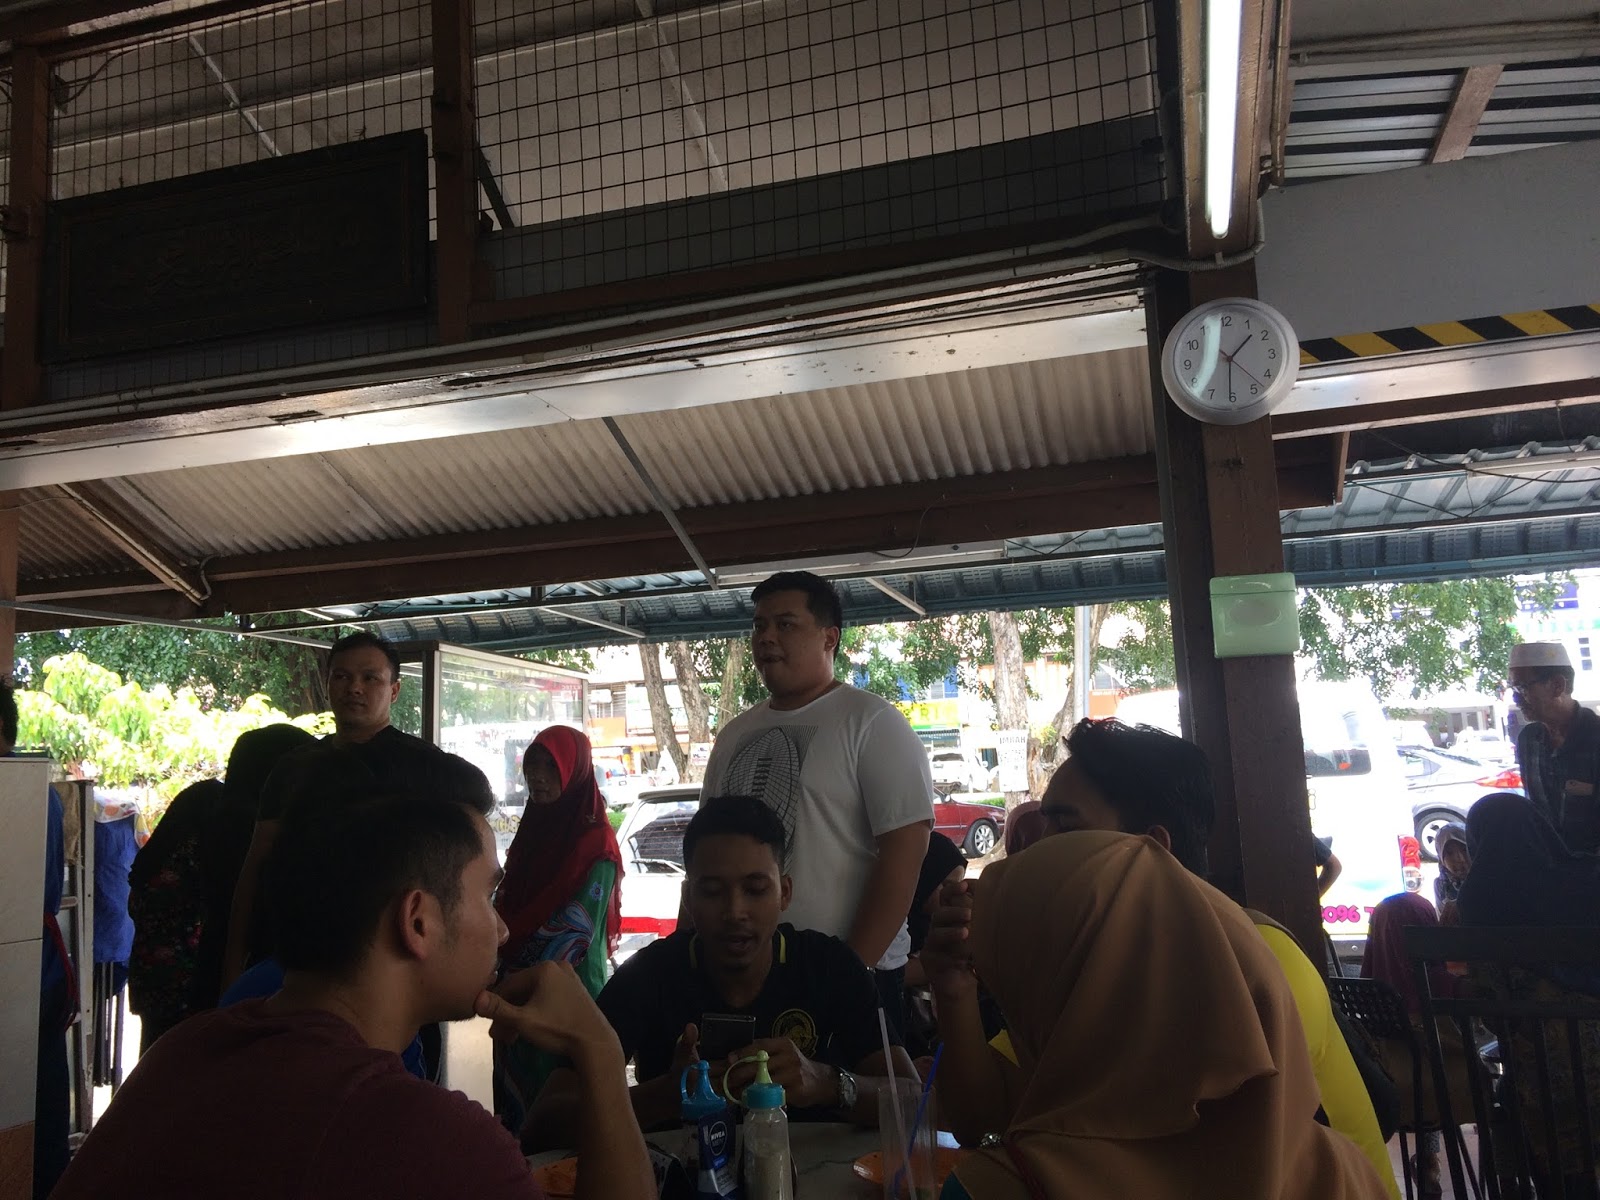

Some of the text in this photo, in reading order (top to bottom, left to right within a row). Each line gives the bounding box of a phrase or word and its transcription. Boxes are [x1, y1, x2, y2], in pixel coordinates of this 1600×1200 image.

[1220, 316, 1232, 327] 12
[1245, 320, 1251, 330] 1
[1261, 330, 1269, 341] 2
[1186, 340, 1199, 351] 10
[1268, 348, 1276, 359] 3
[1184, 360, 1192, 370] 9
[1264, 369, 1272, 378] 4
[1208, 389, 1216, 399] 7
[1250, 384, 1258, 394] 5
[1229, 392, 1237, 402] 6
[1321, 904, 1361, 923] 096
[710, 1131, 725, 1141] NIVEA
